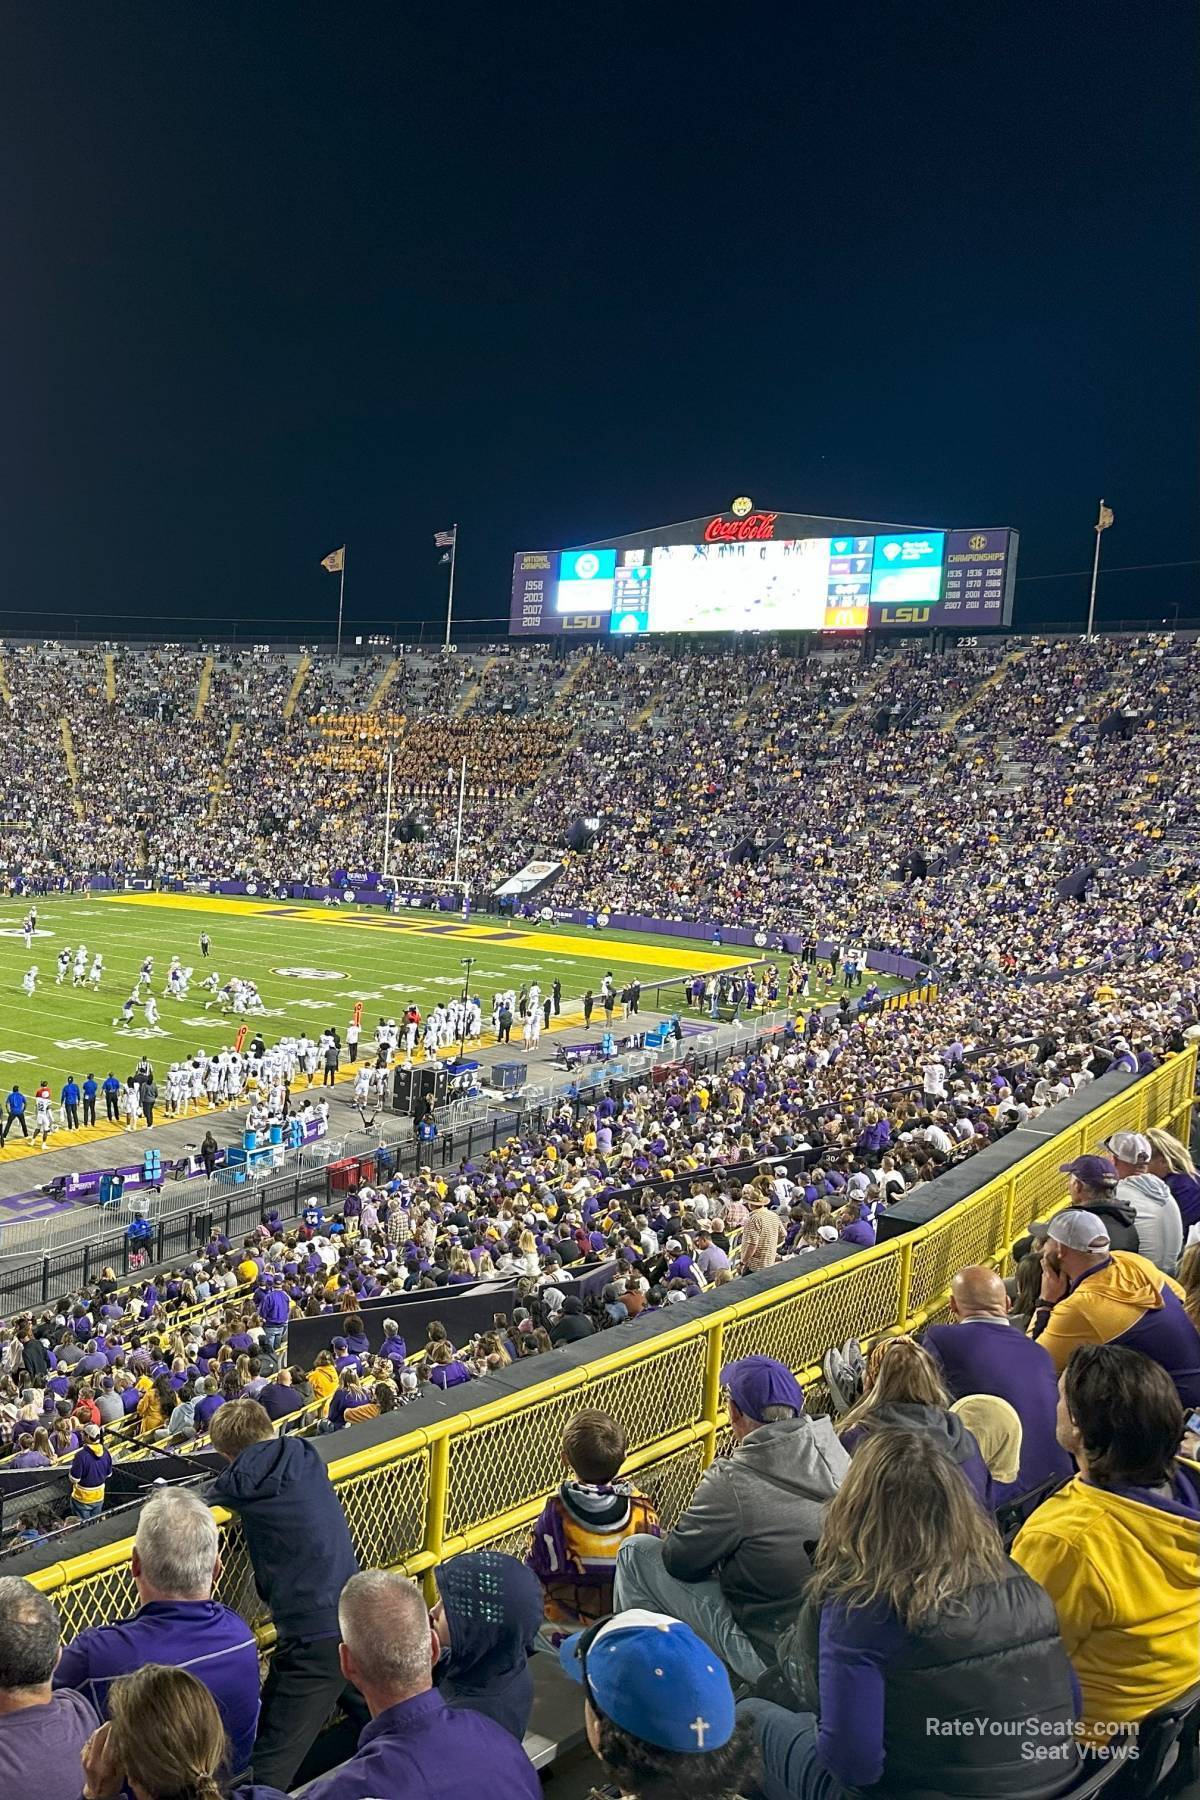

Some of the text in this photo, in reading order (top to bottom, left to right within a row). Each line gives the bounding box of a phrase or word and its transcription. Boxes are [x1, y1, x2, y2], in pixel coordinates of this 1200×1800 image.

[705, 514, 778, 541] Coca-Cola
[970, 537, 986, 548] SEC
[948, 552, 1005, 563] CHAMPIONSHIPS
[947, 568, 1002, 578] 1935 1936 1958
[525, 581, 543, 590] 1958
[947, 580, 961, 588] 1961
[966, 580, 981, 588] 1970
[523, 593, 543, 602] 2003
[984, 590, 1000, 598] 2003
[523, 605, 542, 615] 2007
[944, 601, 1000, 610] 2007 2011 2019
[881, 607, 930, 623] LSU
[522, 617, 541, 627] 2019
[562, 615, 601, 629] LSU
[957, 637, 978, 647] 235
[250, 908, 538, 941] LSU
[305, 1216, 319, 1225] 44
